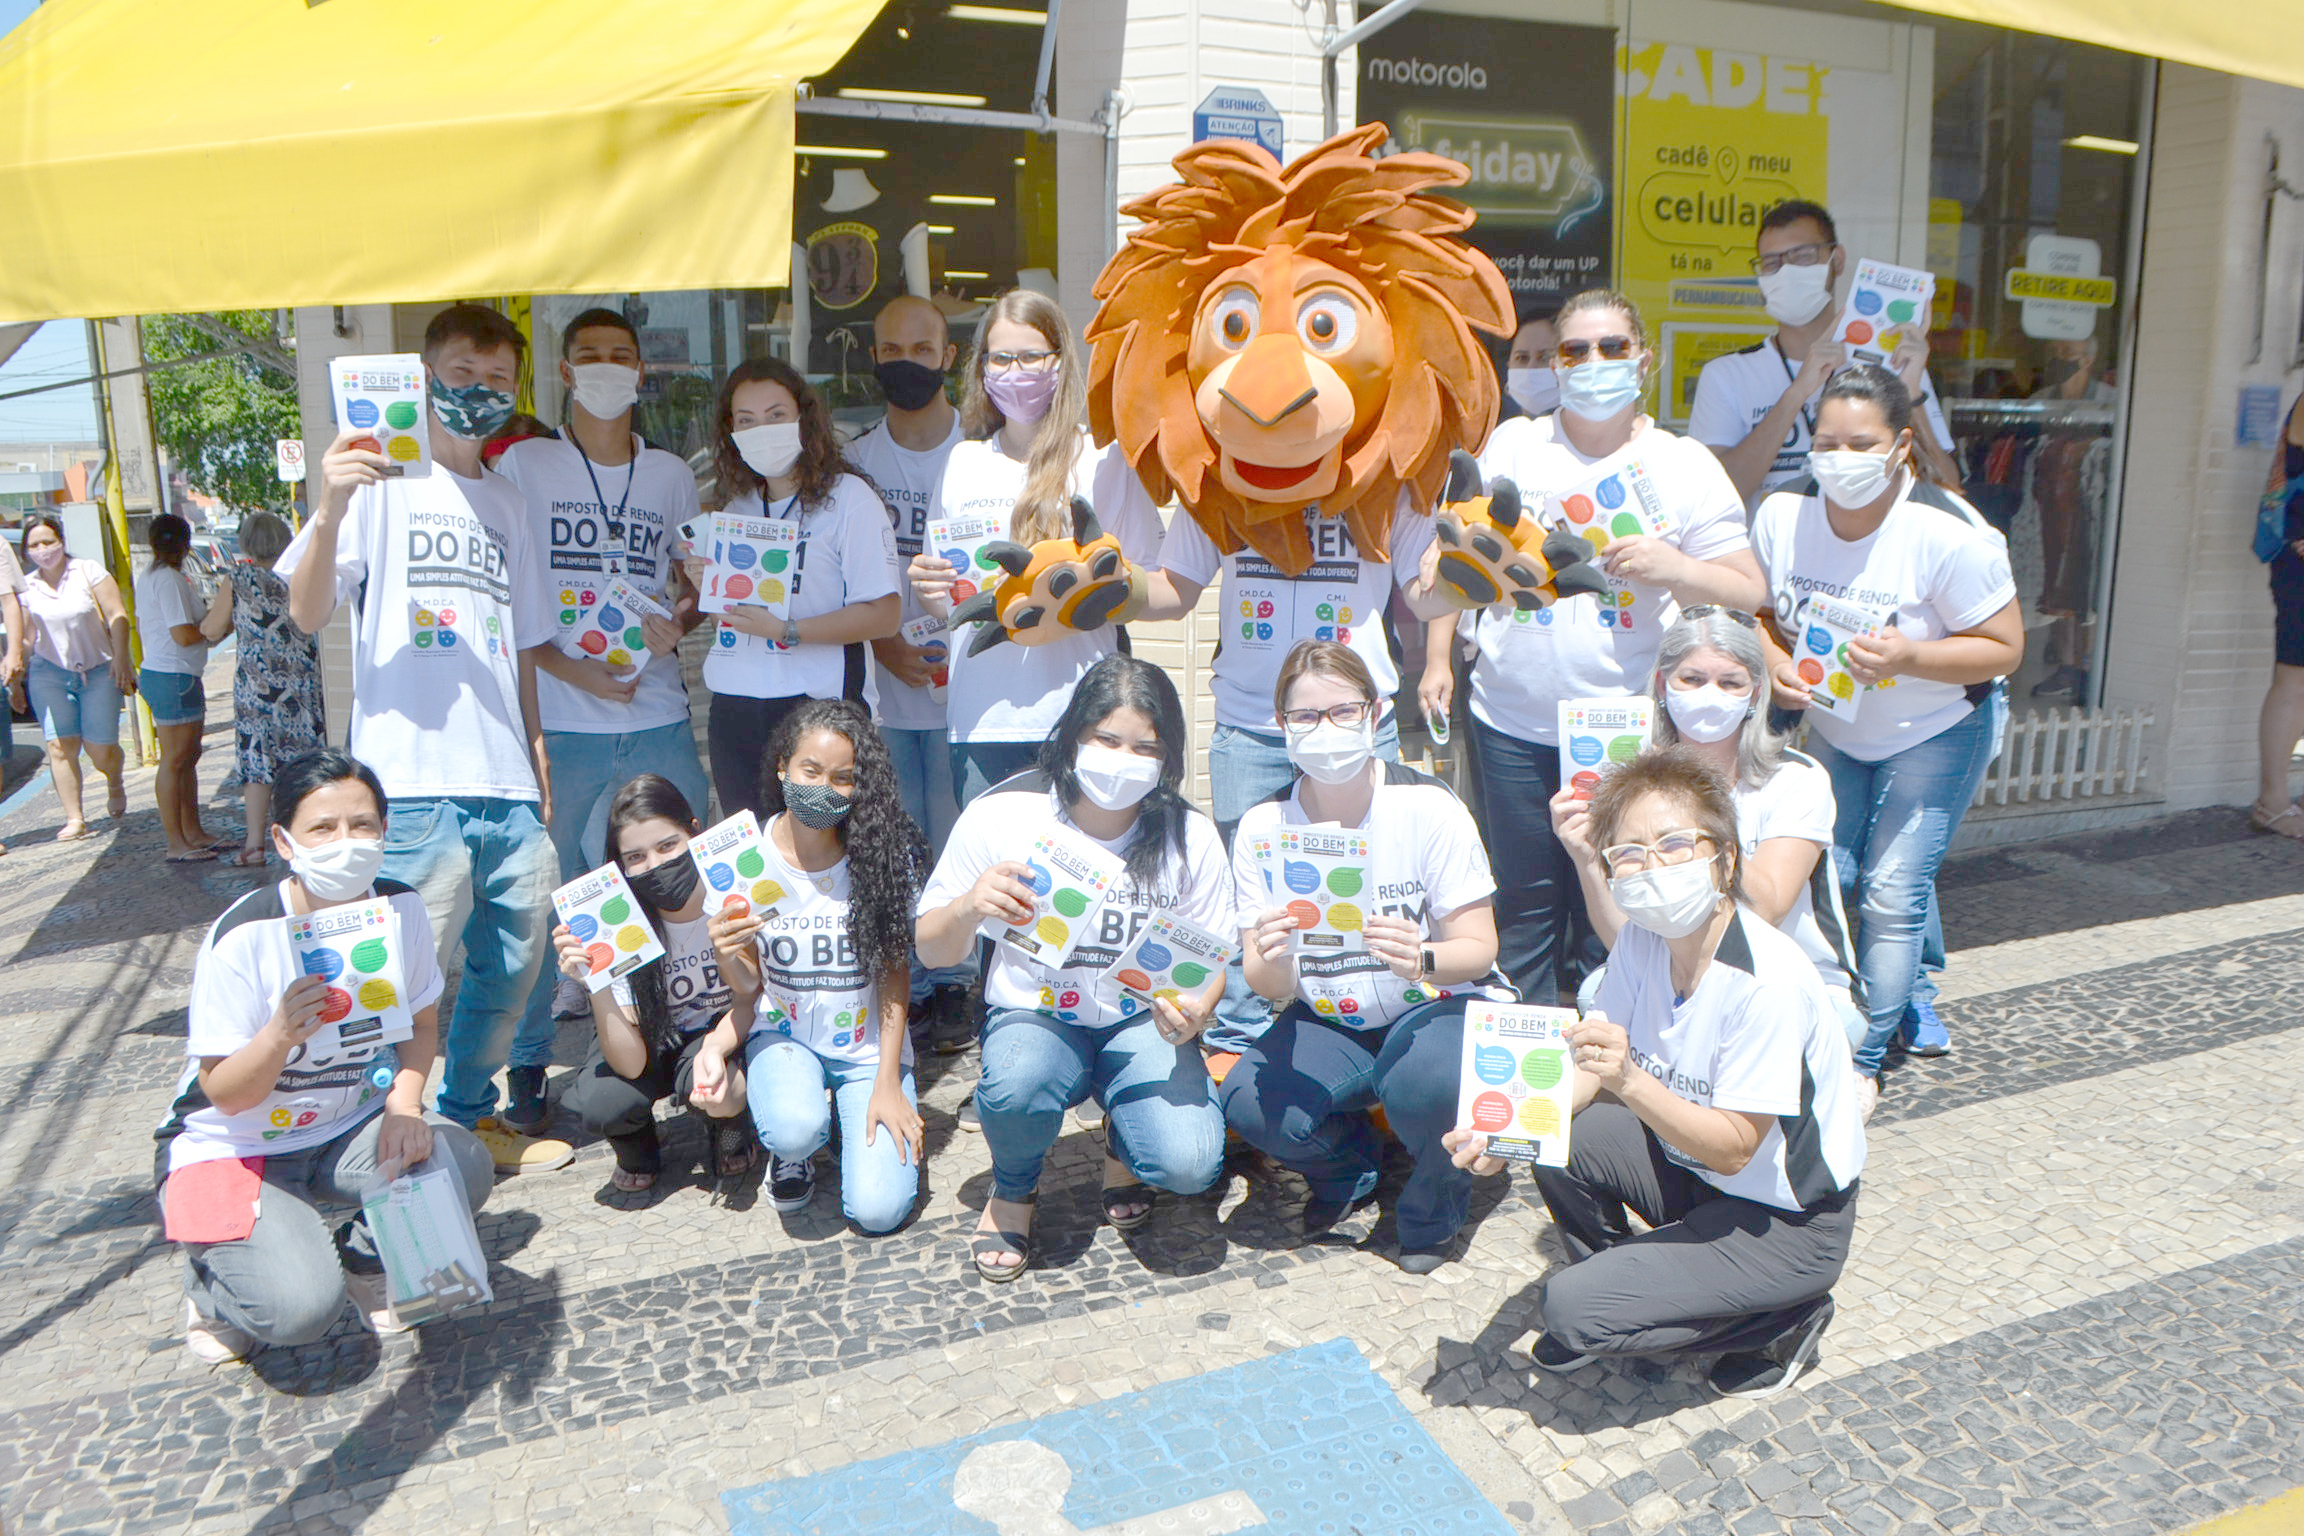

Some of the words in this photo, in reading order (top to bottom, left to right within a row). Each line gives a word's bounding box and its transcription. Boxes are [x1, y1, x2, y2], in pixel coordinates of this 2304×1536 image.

[1369, 57, 1487, 90] motorola
[1210, 120, 1255, 134] ATENÇÃO
[1656, 144, 1709, 167] cadê
[1750, 153, 1791, 172] meu
[1529, 254, 1550, 270] dar
[1554, 258, 1575, 271] um
[1579, 256, 1599, 270] UP
[1671, 252, 1687, 269] tá
[1693, 257, 1712, 270] na
[1507, 275, 1560, 290] otorola!
[363, 376, 377, 384] DO
[380, 376, 400, 386] BEM
[914, 492, 927, 504] DE
[1638, 479, 1650, 494] DO
[1645, 493, 1660, 514] BEM
[960, 498, 1016, 512] IMPOSTO
[552, 501, 607, 515] IMPOSTO
[612, 505, 626, 517] DE
[630, 507, 664, 526] RENDA
[409, 512, 467, 529] IMPOSTO
[469, 519, 482, 534] DE
[746, 525, 759, 534] DO
[761, 526, 778, 535] BEM
[950, 526, 963, 535] DO
[965, 524, 983, 533] BEM
[551, 518, 598, 548] DO
[409, 530, 459, 562] DO
[410, 573, 426, 582] UMA
[426, 572, 449, 582] SIMPLES
[1247, 563, 1269, 574] SIMPLES
[1309, 568, 1326, 577] TODA
[1327, 567, 1357, 579] DIFERENÇ
[627, 596, 639, 607] DO
[1239, 590, 1275, 598] C.M.D.C.A.
[1839, 586, 1856, 600] DE
[1858, 589, 1899, 606] RENDA
[1828, 608, 1841, 620] DO
[1843, 613, 1860, 627] BEM
[1588, 713, 1602, 722] DO
[1606, 713, 1627, 722] BEM
[707, 839, 720, 850] DO
[720, 830, 737, 844] BEM
[1303, 837, 1319, 848] DO
[1322, 838, 1345, 850] BEM
[1054, 847, 1069, 862] DO
[1068, 857, 1090, 876] BEM
[568, 891, 581, 902] DO
[581, 881, 600, 896] BEM
[1378, 880, 1427, 900] RENDA
[1106, 889, 1126, 904] DE
[1131, 891, 1179, 909] RENDA
[316, 920, 334, 931] DO
[337, 914, 361, 927] BEM
[771, 916, 809, 930] OSTO
[814, 916, 832, 929] DE
[1173, 928, 1189, 941] DO
[1189, 936, 1211, 951] BEM
[663, 955, 698, 974] OSTO
[1071, 952, 1099, 962] ATITUDE
[1101, 954, 1113, 963] FAZ
[1302, 962, 1316, 971] UMA
[1316, 960, 1342, 972] SIMPLES
[1343, 956, 1369, 968] ATITUDE
[670, 975, 693, 1000] O
[789, 976, 814, 987] ATITUDE
[815, 976, 827, 986] FAZ
[827, 976, 845, 987] TODA
[1038, 976, 1081, 988] C.M.D.C.A.
[1311, 987, 1355, 997] C.M.D.C.A.
[1500, 1017, 1516, 1029] DO
[1521, 1019, 1546, 1031] BEM
[318, 1071, 345, 1081] ATITUDE
[347, 1070, 360, 1079] FAZ
